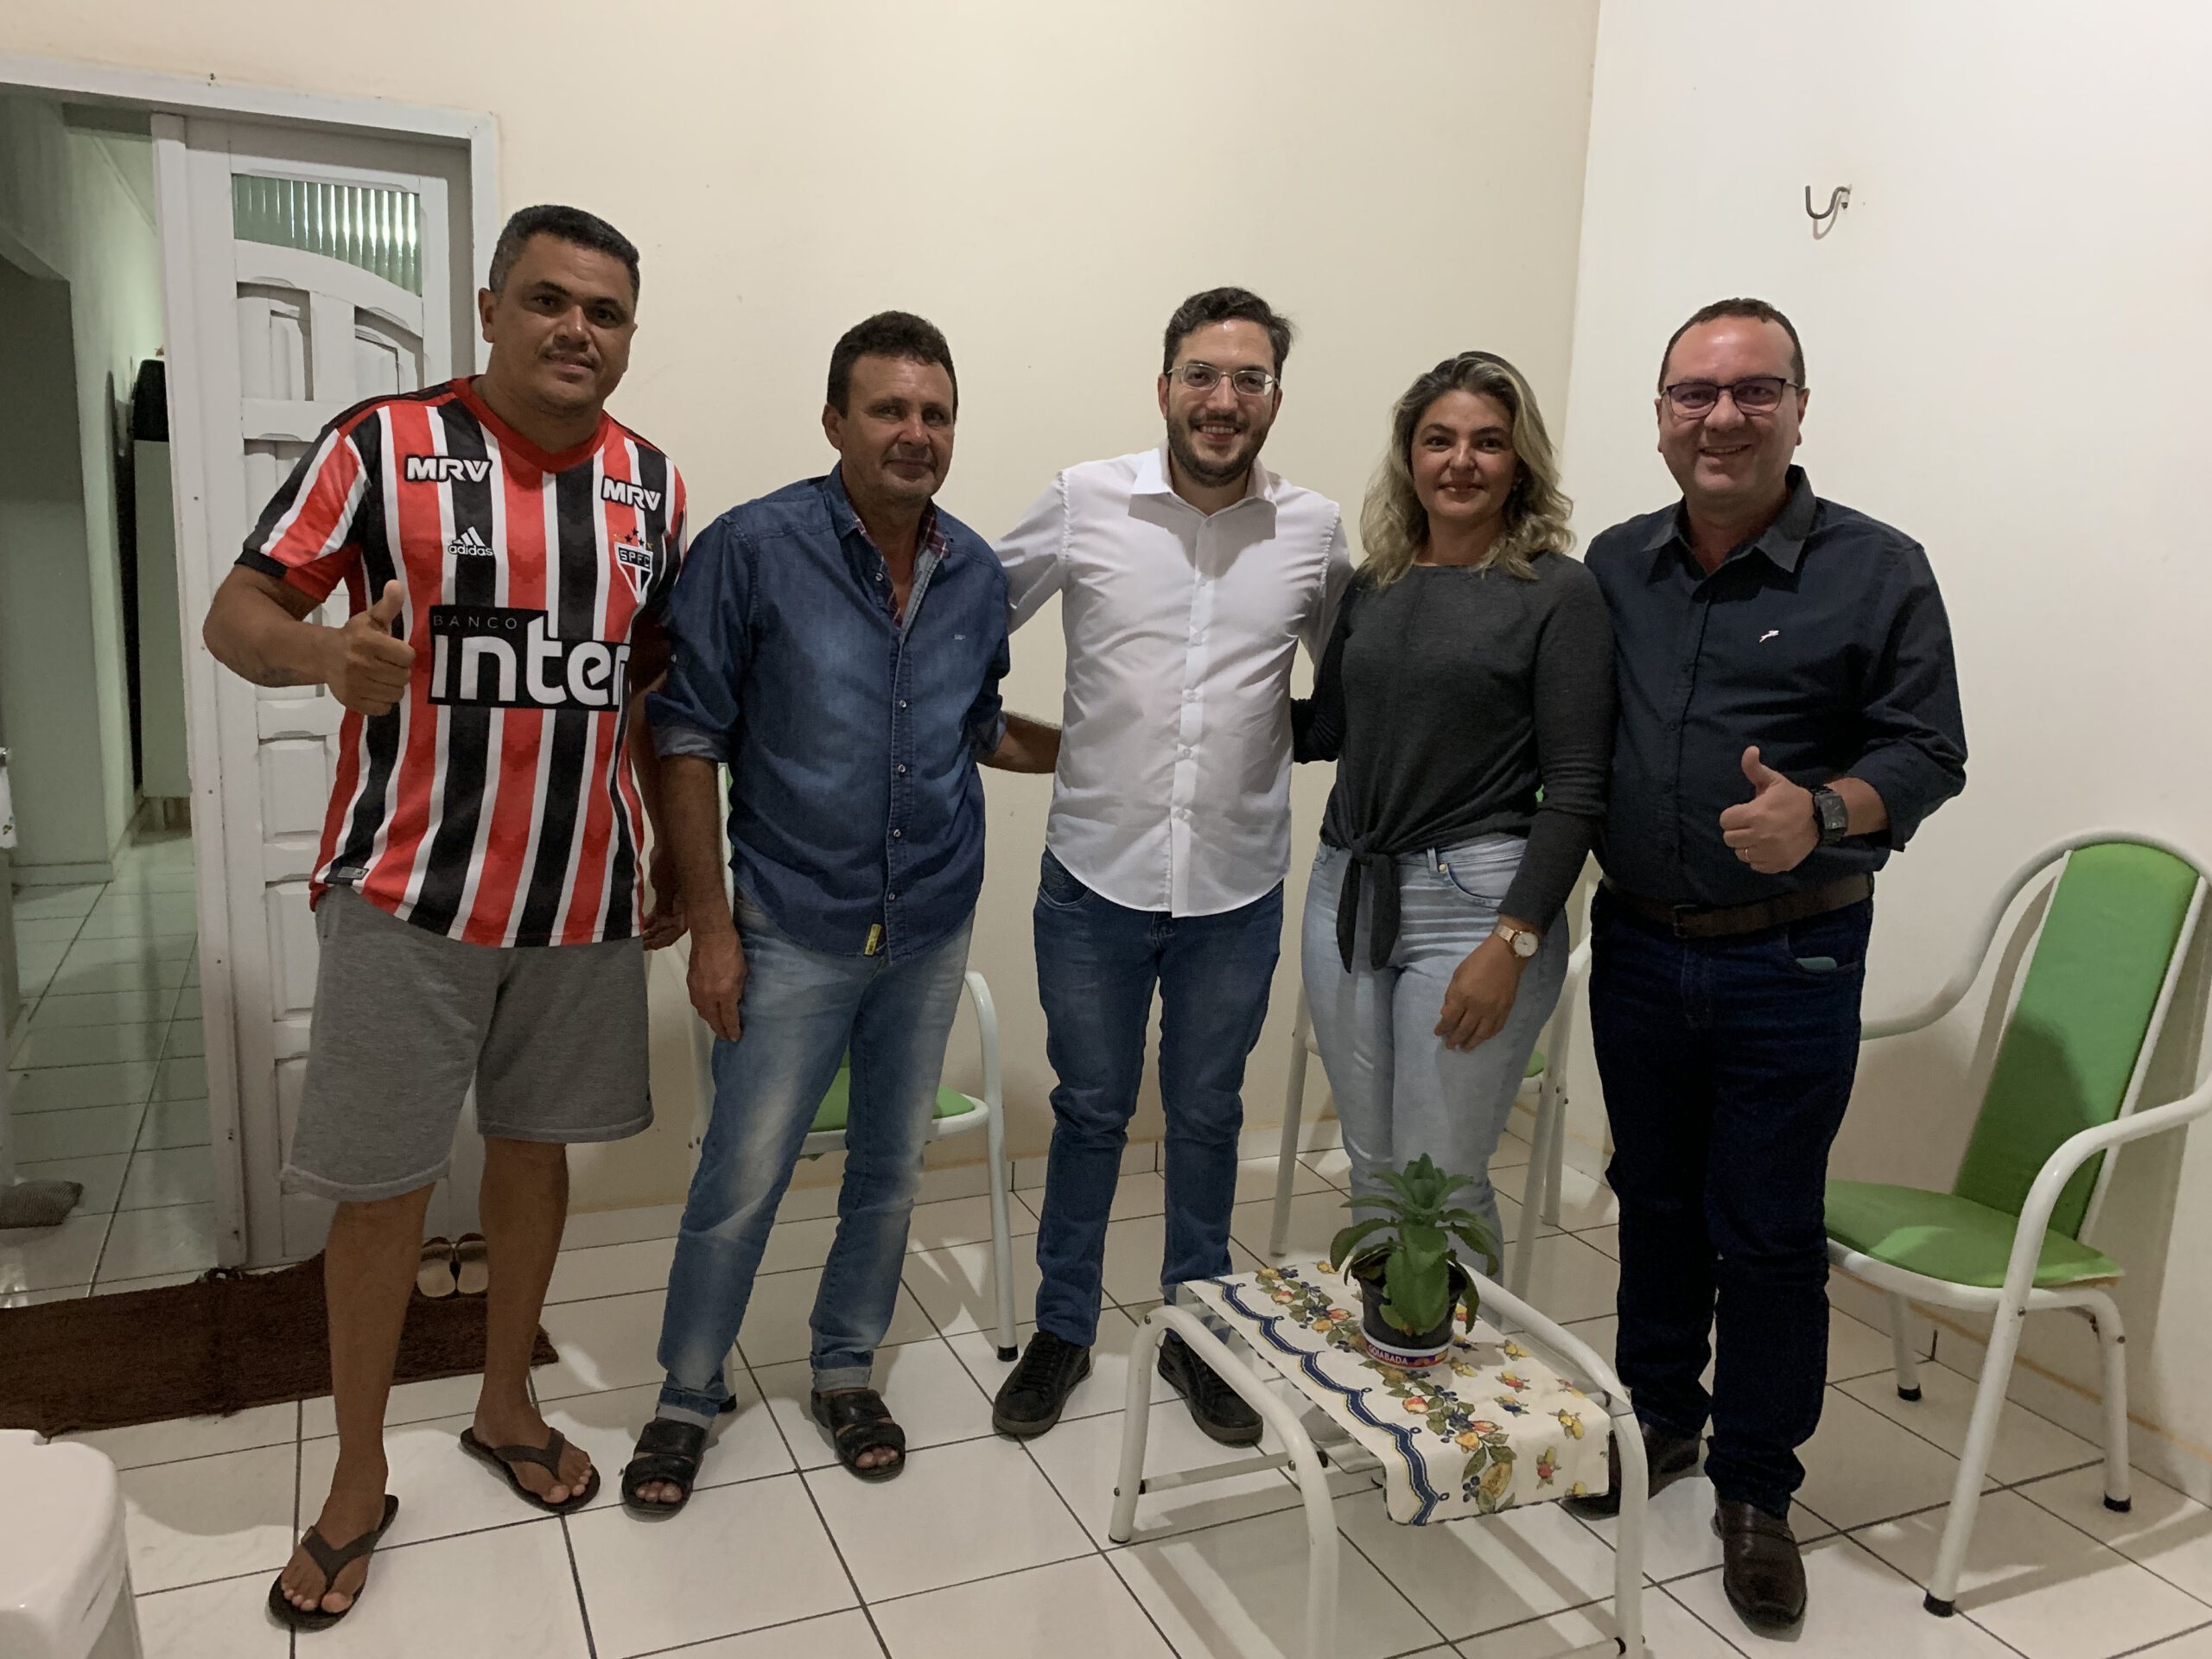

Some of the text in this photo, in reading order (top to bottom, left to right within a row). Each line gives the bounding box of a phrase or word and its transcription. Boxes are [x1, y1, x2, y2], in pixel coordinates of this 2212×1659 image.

[406, 457, 491, 482] MRV
[602, 477, 662, 512] MRV
[448, 543, 493, 556] adidas
[619, 550, 651, 568] SPFC
[433, 614, 518, 630] BANCO
[1368, 1344, 1408, 1365] GOIABADA
